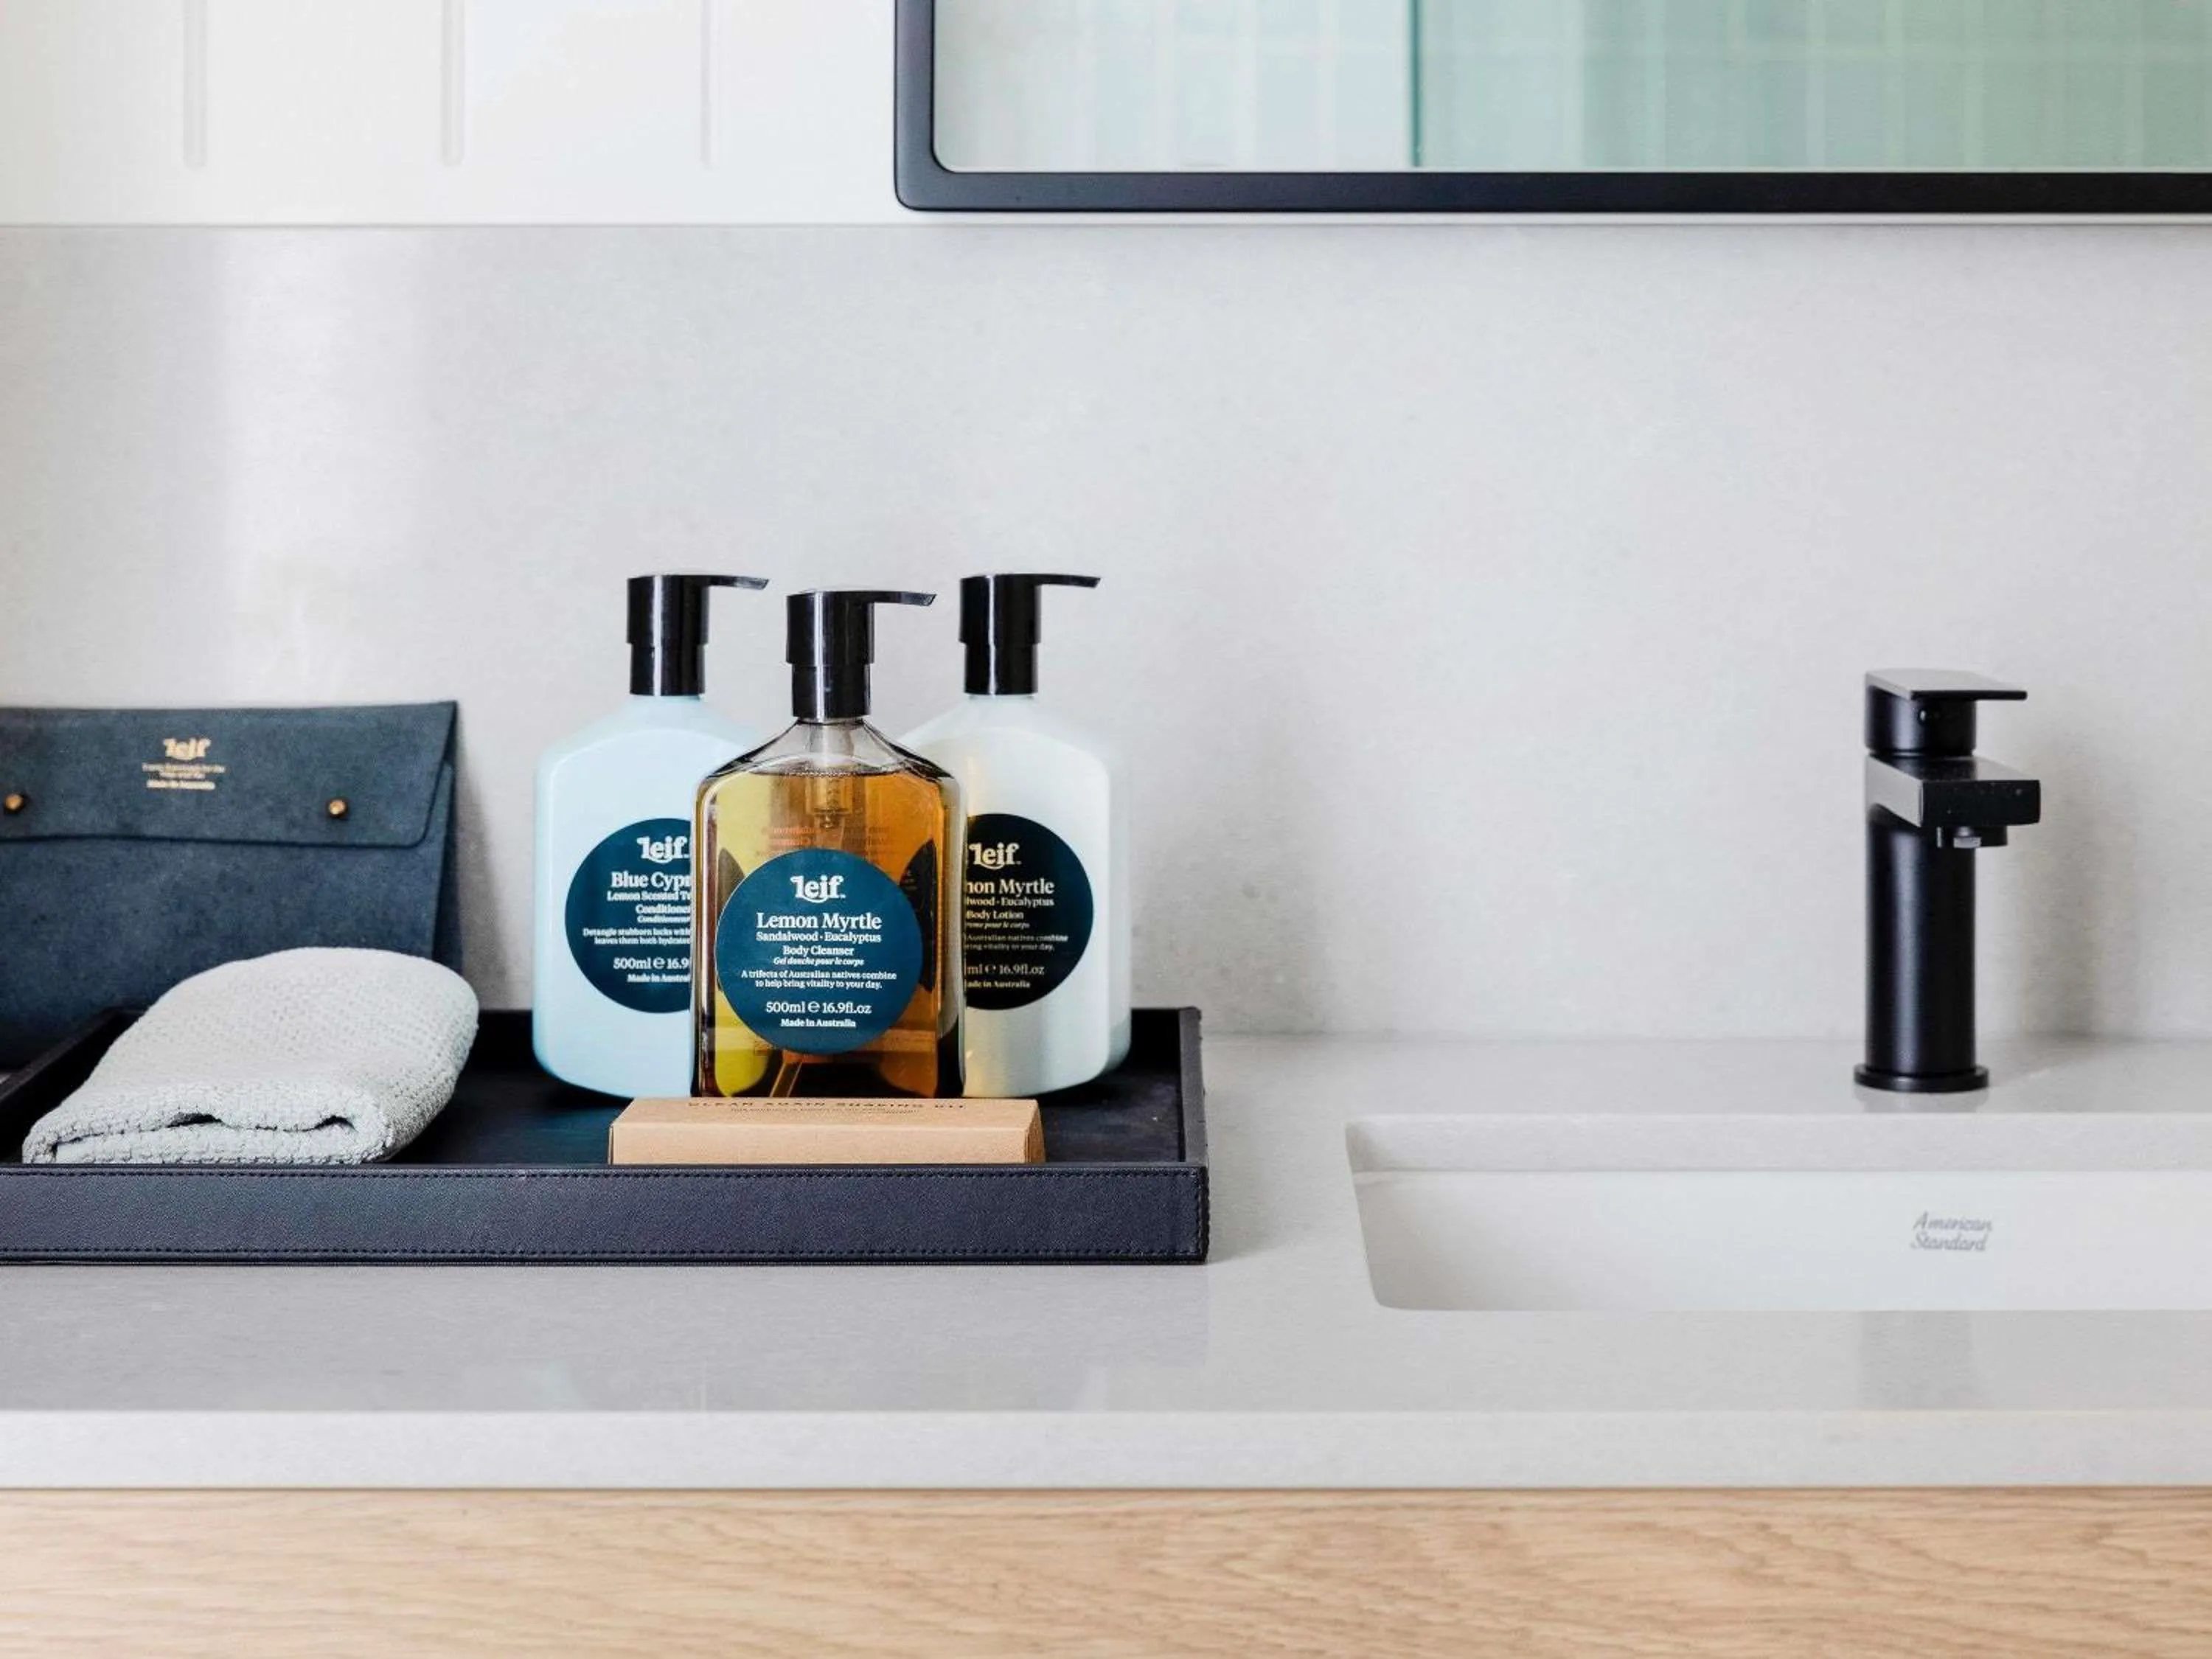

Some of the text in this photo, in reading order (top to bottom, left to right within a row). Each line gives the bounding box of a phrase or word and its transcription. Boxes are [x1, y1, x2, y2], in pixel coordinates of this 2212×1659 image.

[611, 871, 649, 888] Blue
[998, 877, 1055, 897] Myrtle
[607, 891, 641, 901] Lemon
[641, 891, 679, 901] Scented
[1001, 897, 1054, 908] Eucalyptus
[993, 911, 1025, 919] Lotion
[756, 912, 883, 932] Lemon Myrtle
[756, 931, 882, 945] Sandalwood Eucalyptus
[783, 945, 855, 957] Body Cleanser
[613, 956, 651, 970] 500ml
[773, 957, 787, 965] Gel
[627, 973, 650, 983] Made
[651, 973, 661, 983] in
[741, 970, 897, 981] A trifecta of Australian natives combine
[755, 979, 764, 988] to
[765, 979, 782, 990] help
[807, 979, 835, 990] vitality
[835, 980, 844, 988] to
[846, 981, 864, 990] your
[766, 1001, 805, 1014] 500ml
[780, 1018, 857, 1029] Made in Australia
